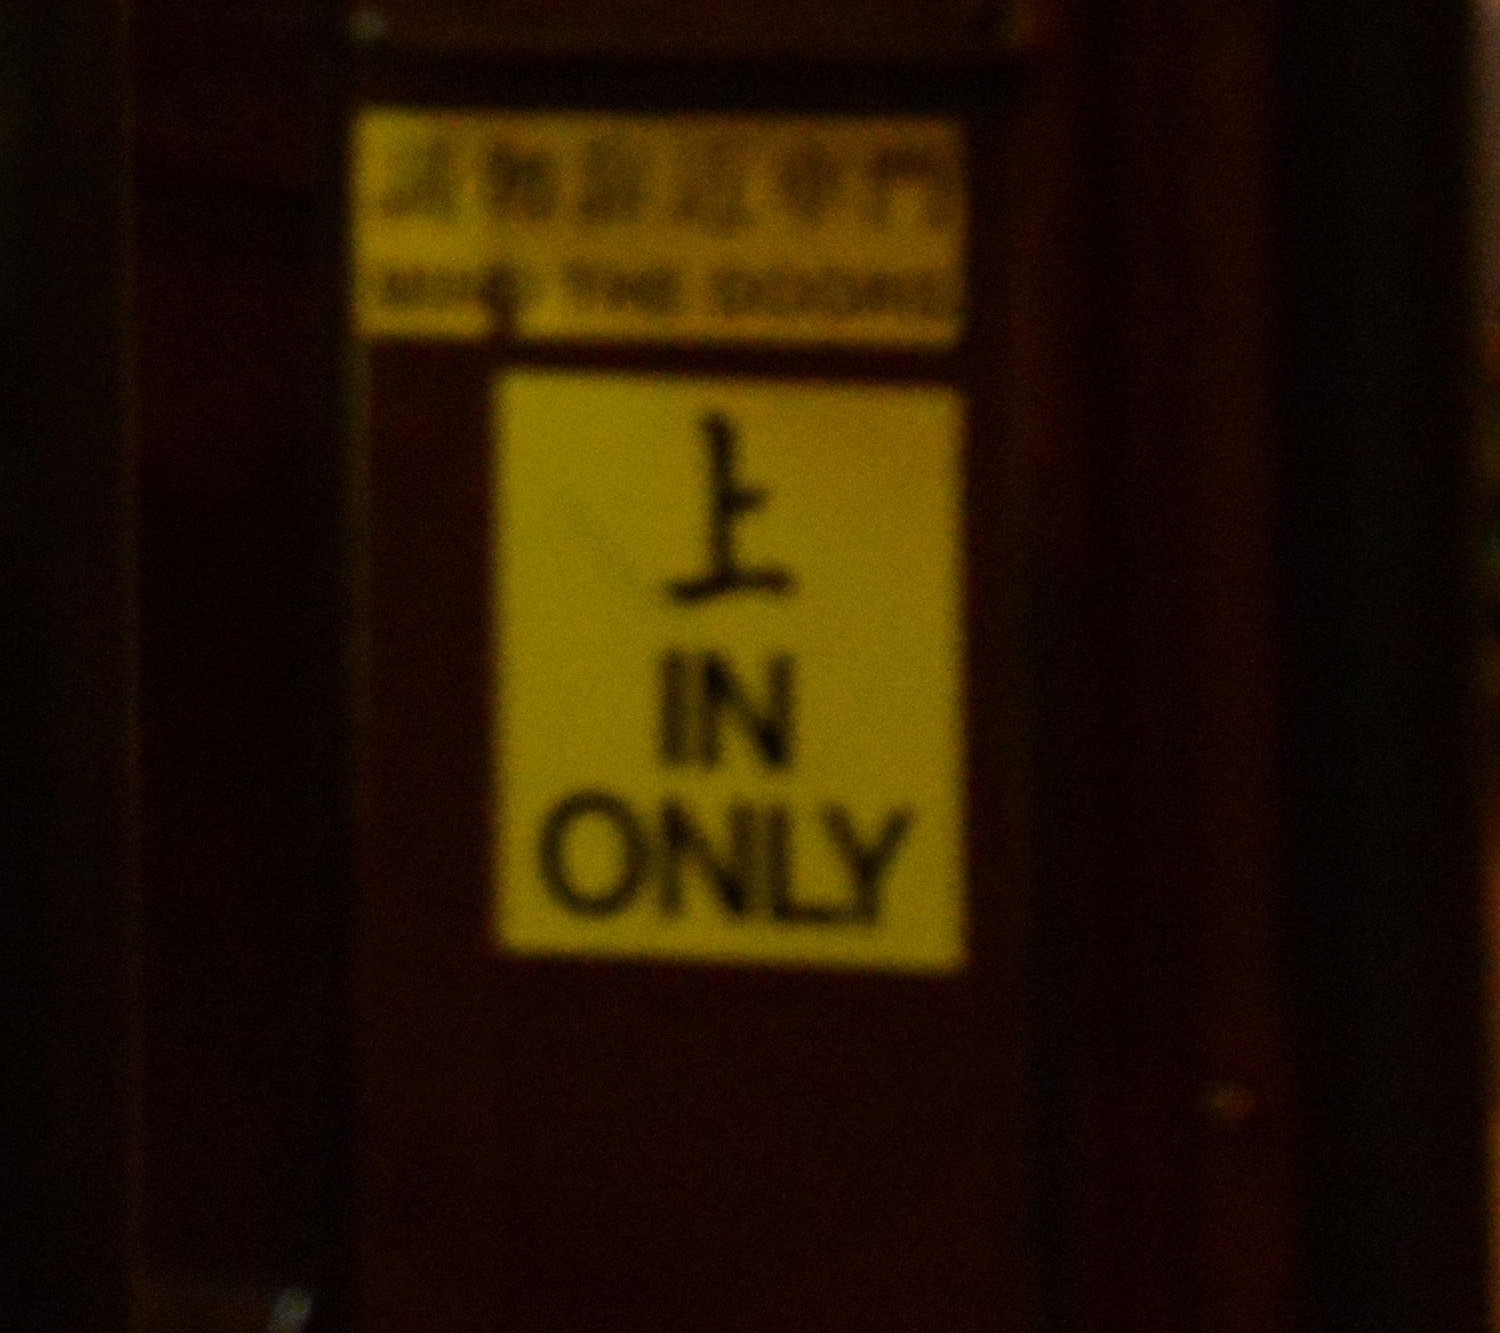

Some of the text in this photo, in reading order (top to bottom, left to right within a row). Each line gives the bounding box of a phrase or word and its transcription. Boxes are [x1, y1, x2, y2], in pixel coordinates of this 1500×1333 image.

[662, 408, 795, 605] 上
[658, 646, 795, 770] IN
[539, 790, 915, 929] ONLY
